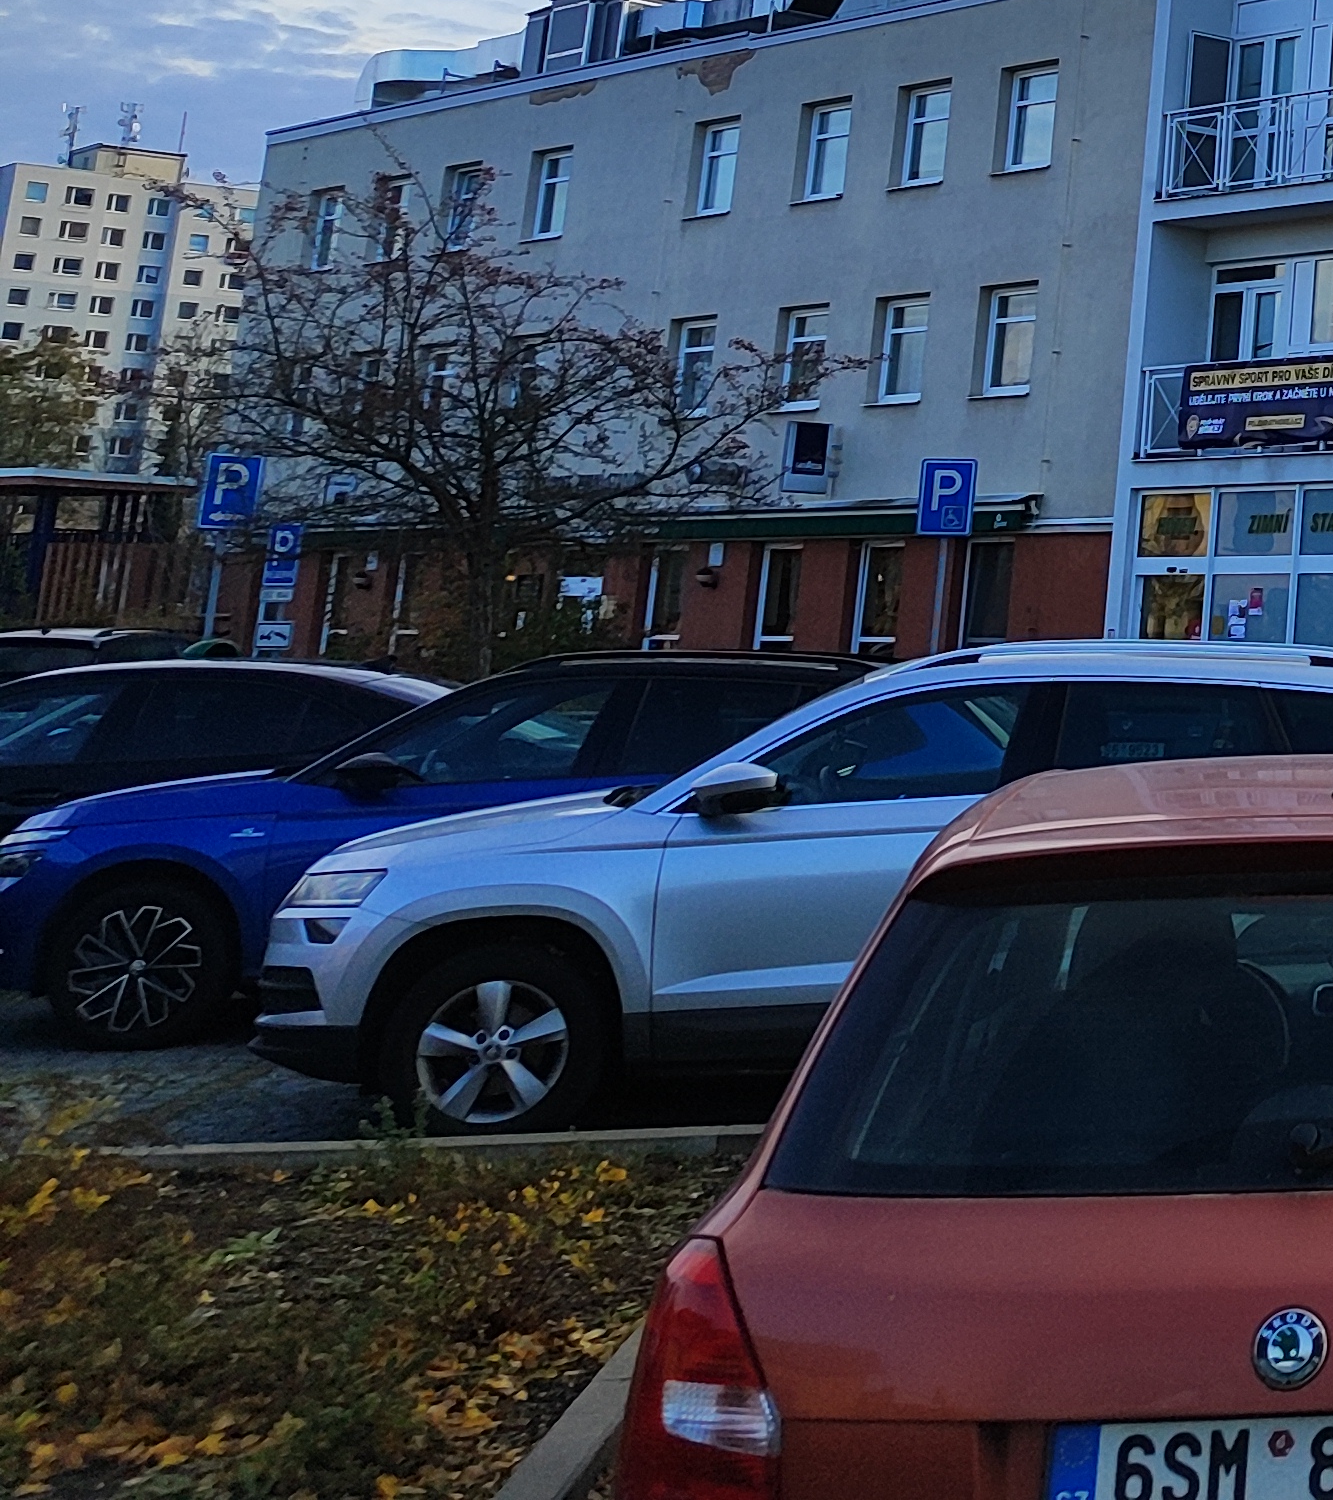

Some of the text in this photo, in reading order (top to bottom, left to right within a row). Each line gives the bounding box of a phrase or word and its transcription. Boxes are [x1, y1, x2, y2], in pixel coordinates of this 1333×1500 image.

[1239, 371, 1269, 384] SPORT
[1272, 369, 1291, 382] PRO
[1294, 365, 1320, 380] VAŠE
[1275, 389, 1281, 401] A
[1319, 387, 1327, 398] U
[213, 463, 250, 505] P
[931, 469, 963, 511] P
[1248, 508, 1293, 534] ZIMNÍ
[1113, 1428, 1250, 1500] 6SM
